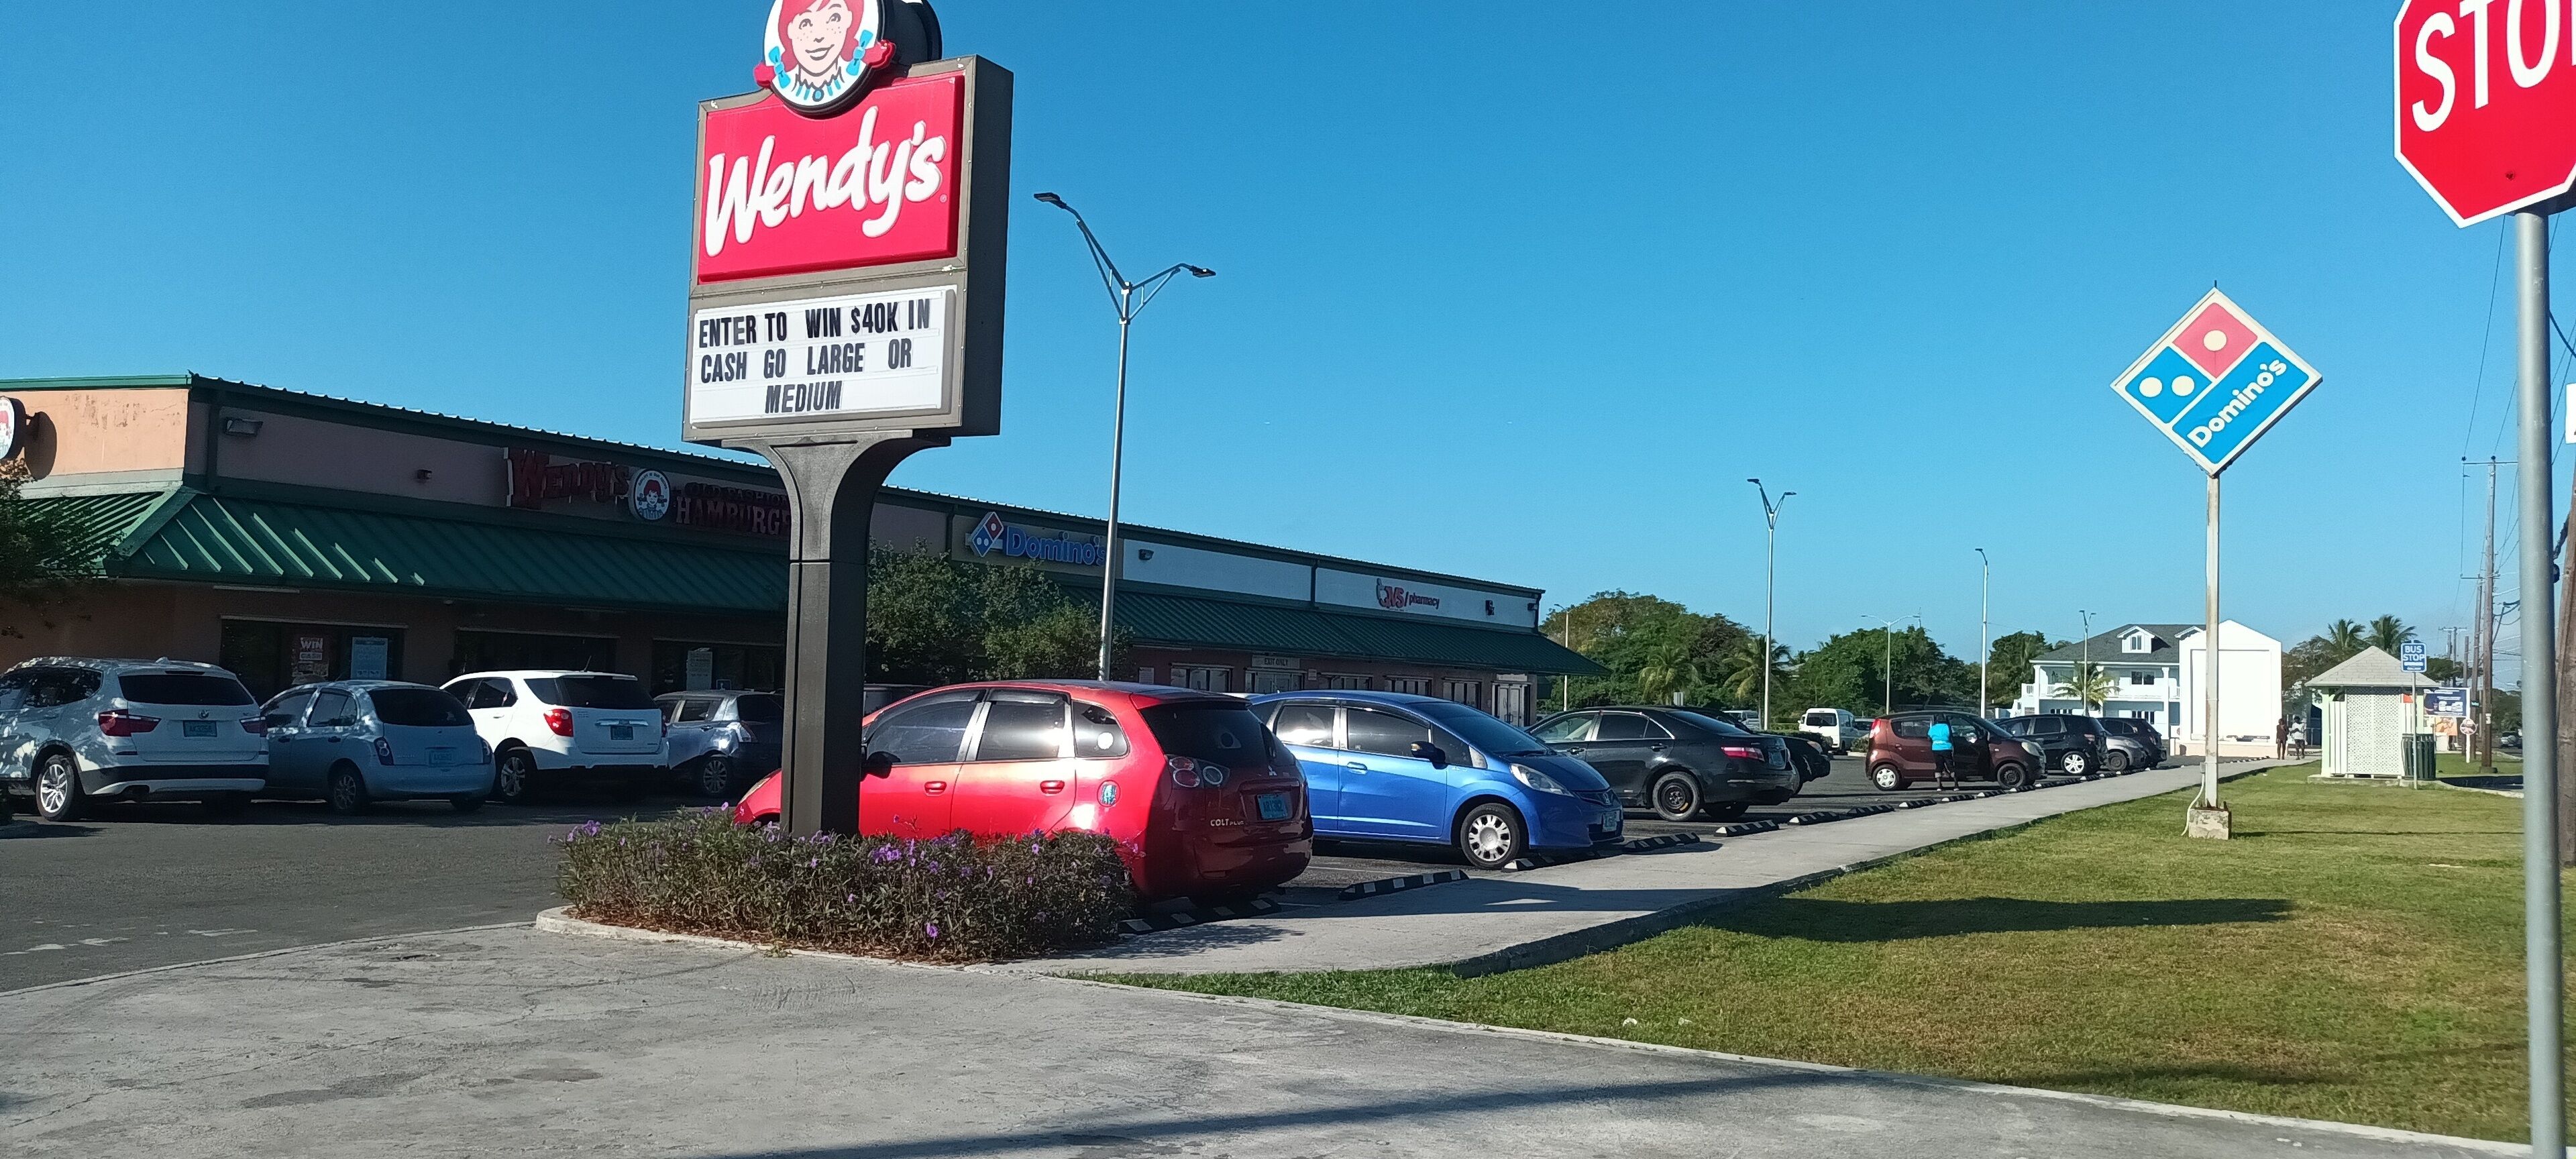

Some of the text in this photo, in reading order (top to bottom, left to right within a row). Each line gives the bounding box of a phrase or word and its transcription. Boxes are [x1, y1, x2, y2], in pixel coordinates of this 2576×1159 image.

[2412, 0, 2576, 131] STO
[705, 106, 947, 257] Wendy's
[699, 298, 930, 348] ENTER TO WIN $40K IN
[701, 338, 912, 383] CASH GO LARGE OR
[765, 380, 843, 414] MEDIUM
[2187, 359, 2287, 448] Domino's
[1007, 526, 1106, 566] Domino's
[301, 641, 323, 649] WIN
[1264, 658, 1288, 667] EXIT ONLY
[1210, 818, 1229, 827] COLT
